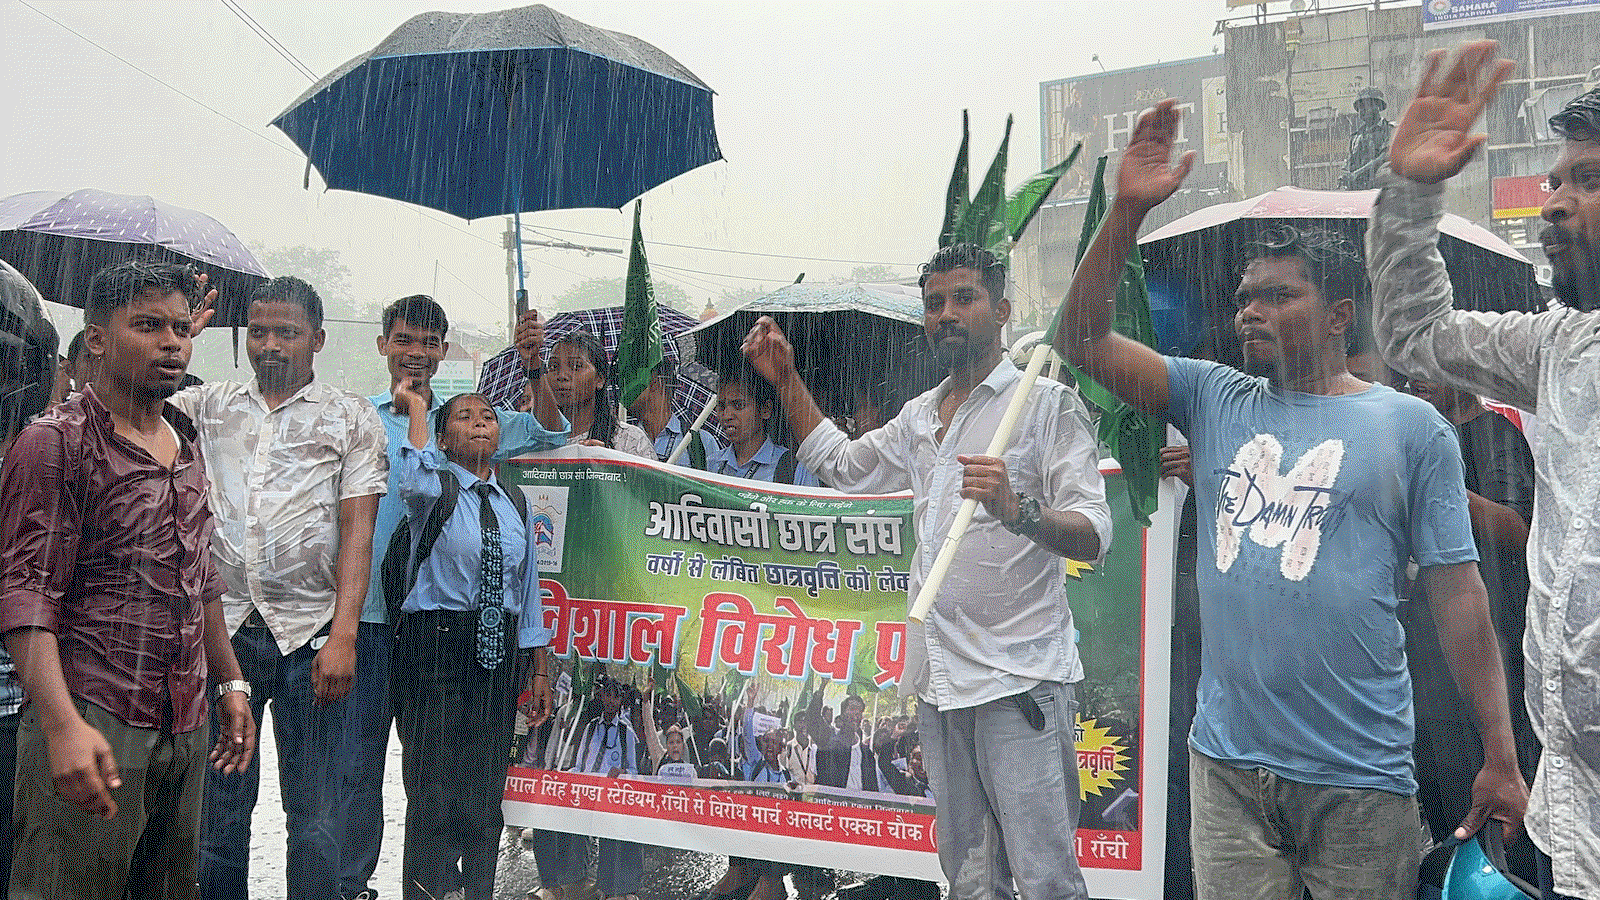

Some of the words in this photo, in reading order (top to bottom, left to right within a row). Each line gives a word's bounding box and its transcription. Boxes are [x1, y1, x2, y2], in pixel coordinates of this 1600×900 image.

[1434, 13, 1458, 21] INDIA
[1459, 8, 1498, 18] PARIWAR
[1451, 1, 1497, 13] SAHARA
[523, 468, 557, 480] आदिवासी
[559, 470, 574, 480] छात्र
[574, 469, 585, 480] संघ
[645, 493, 770, 549] आदिवासी
[773, 513, 838, 554] छात्र
[841, 508, 903, 555] संघ
[687, 553, 708, 579] से
[710, 556, 760, 583] लंबित
[762, 561, 841, 598] छात्रवृत्ति
[844, 566, 871, 592] को
[875, 566, 910, 592] लेक
[695, 591, 864, 684] विरोध
[872, 620, 908, 689] प्र
[1076, 745, 1116, 779] त्रवृत्ति
[504, 775, 538, 794] पाल
[541, 773, 568, 801] सिंह
[571, 782, 604, 807] मुण्डा
[693, 792, 706, 815] से
[708, 794, 748, 821] विरोध
[751, 802, 782, 826] मार्च
[785, 808, 834, 831] अलबर्ट
[838, 816, 884, 837] एक्का
[887, 814, 924, 841] चौक
[1090, 832, 1129, 860] राँची
